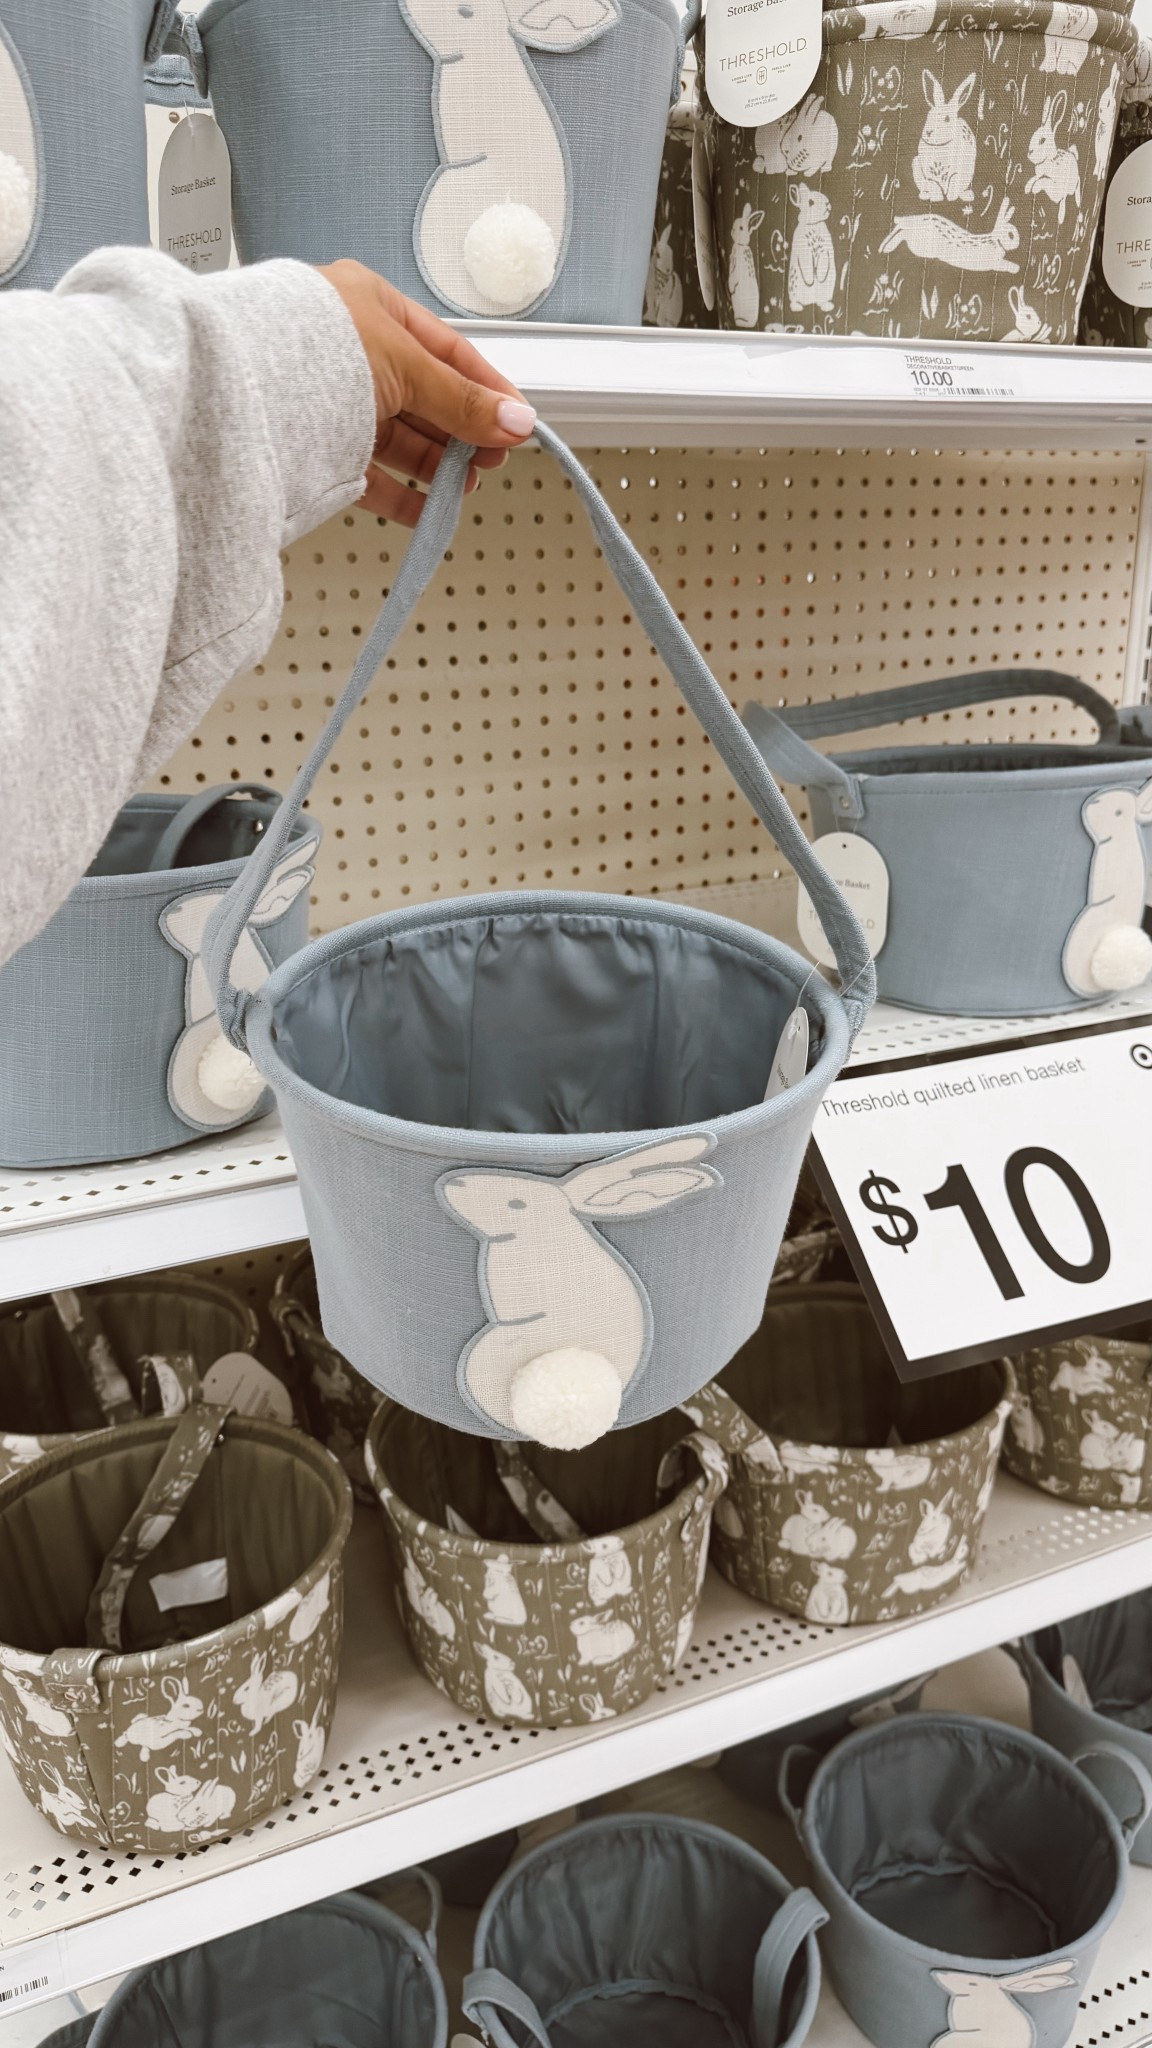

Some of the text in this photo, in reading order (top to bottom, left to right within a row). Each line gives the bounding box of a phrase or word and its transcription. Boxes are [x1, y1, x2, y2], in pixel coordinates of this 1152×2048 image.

[727, 0, 764, 17] Storage
[720, 37, 807, 71] THRESHOLD
[171, 176, 216, 196] Storage Basket
[1126, 196, 1152, 206] Stora
[167, 227, 222, 251] THRESHOLD
[1116, 238, 1152, 254] THRE
[904, 355, 952, 365] THRESHOLD
[911, 370, 953, 386] 10.00
[821, 1057, 1086, 1117] Threshold quilted linen basket
[859, 1146, 1112, 1301] $10
